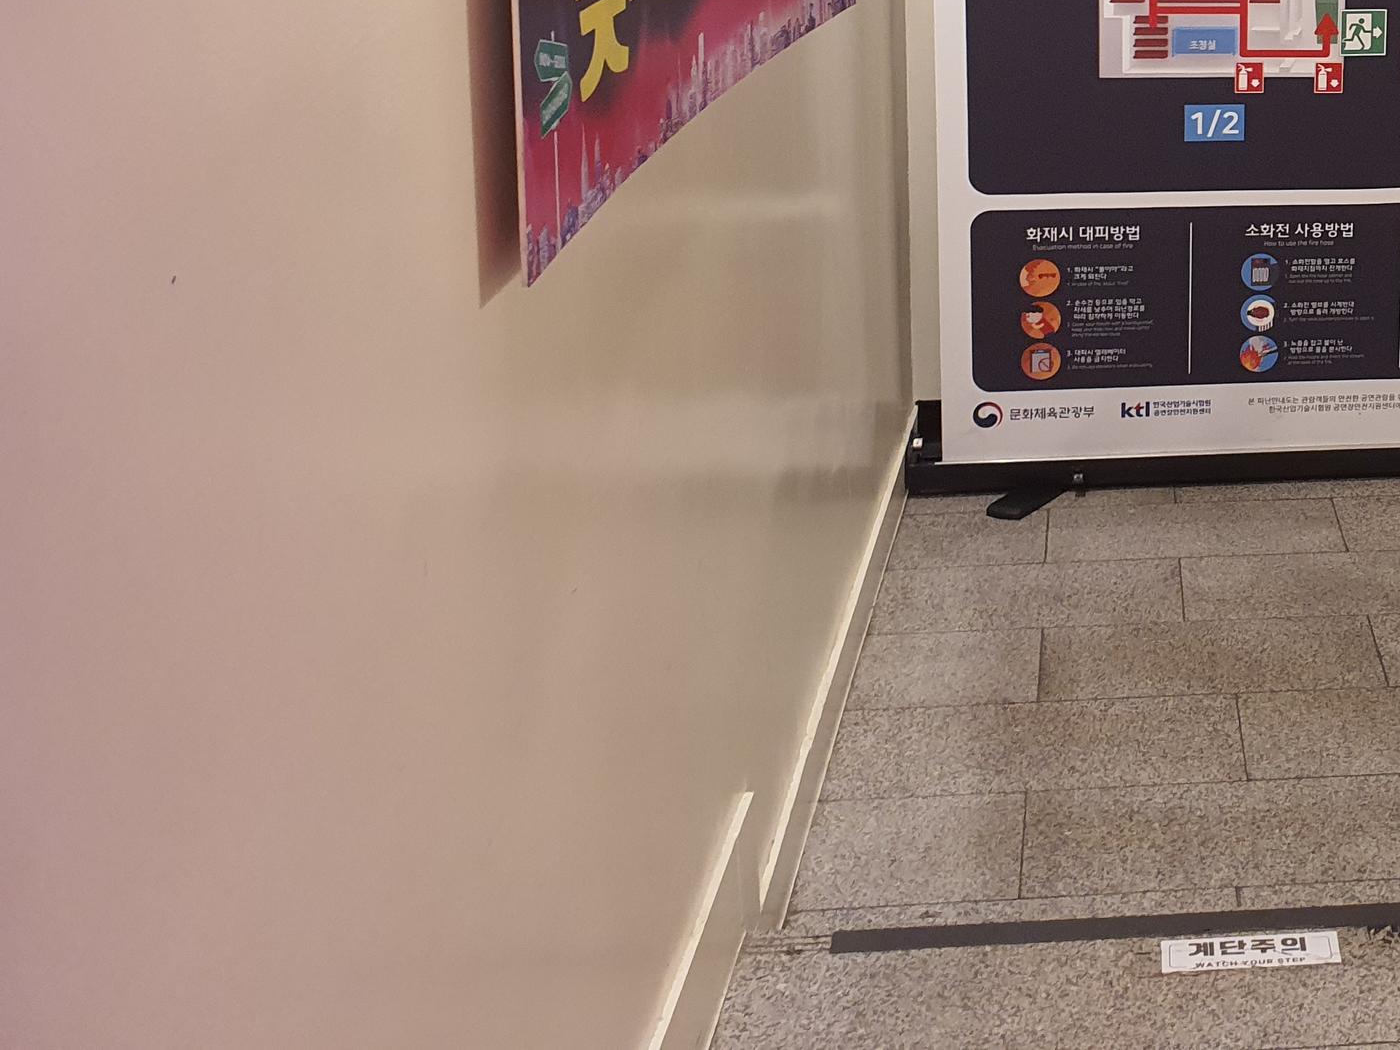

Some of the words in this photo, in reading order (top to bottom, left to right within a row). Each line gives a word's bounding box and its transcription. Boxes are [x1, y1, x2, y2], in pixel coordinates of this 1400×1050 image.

[1190, 109, 1240, 138] 1/2
[1026, 226, 1074, 243] 화재시
[1079, 225, 1140, 242] 대피방법
[1245, 223, 1290, 239] 소화전
[1294, 222, 1354, 238] 사용방법
[1010, 406, 1095, 421] 문화체육관광부
[1121, 401, 1150, 418] ktl
[1188, 936, 1307, 957] 계단주의
[1195, 960, 1238, 969] WATCH
[1240, 958, 1273, 967] YOUR
[1277, 956, 1306, 965] STEP
